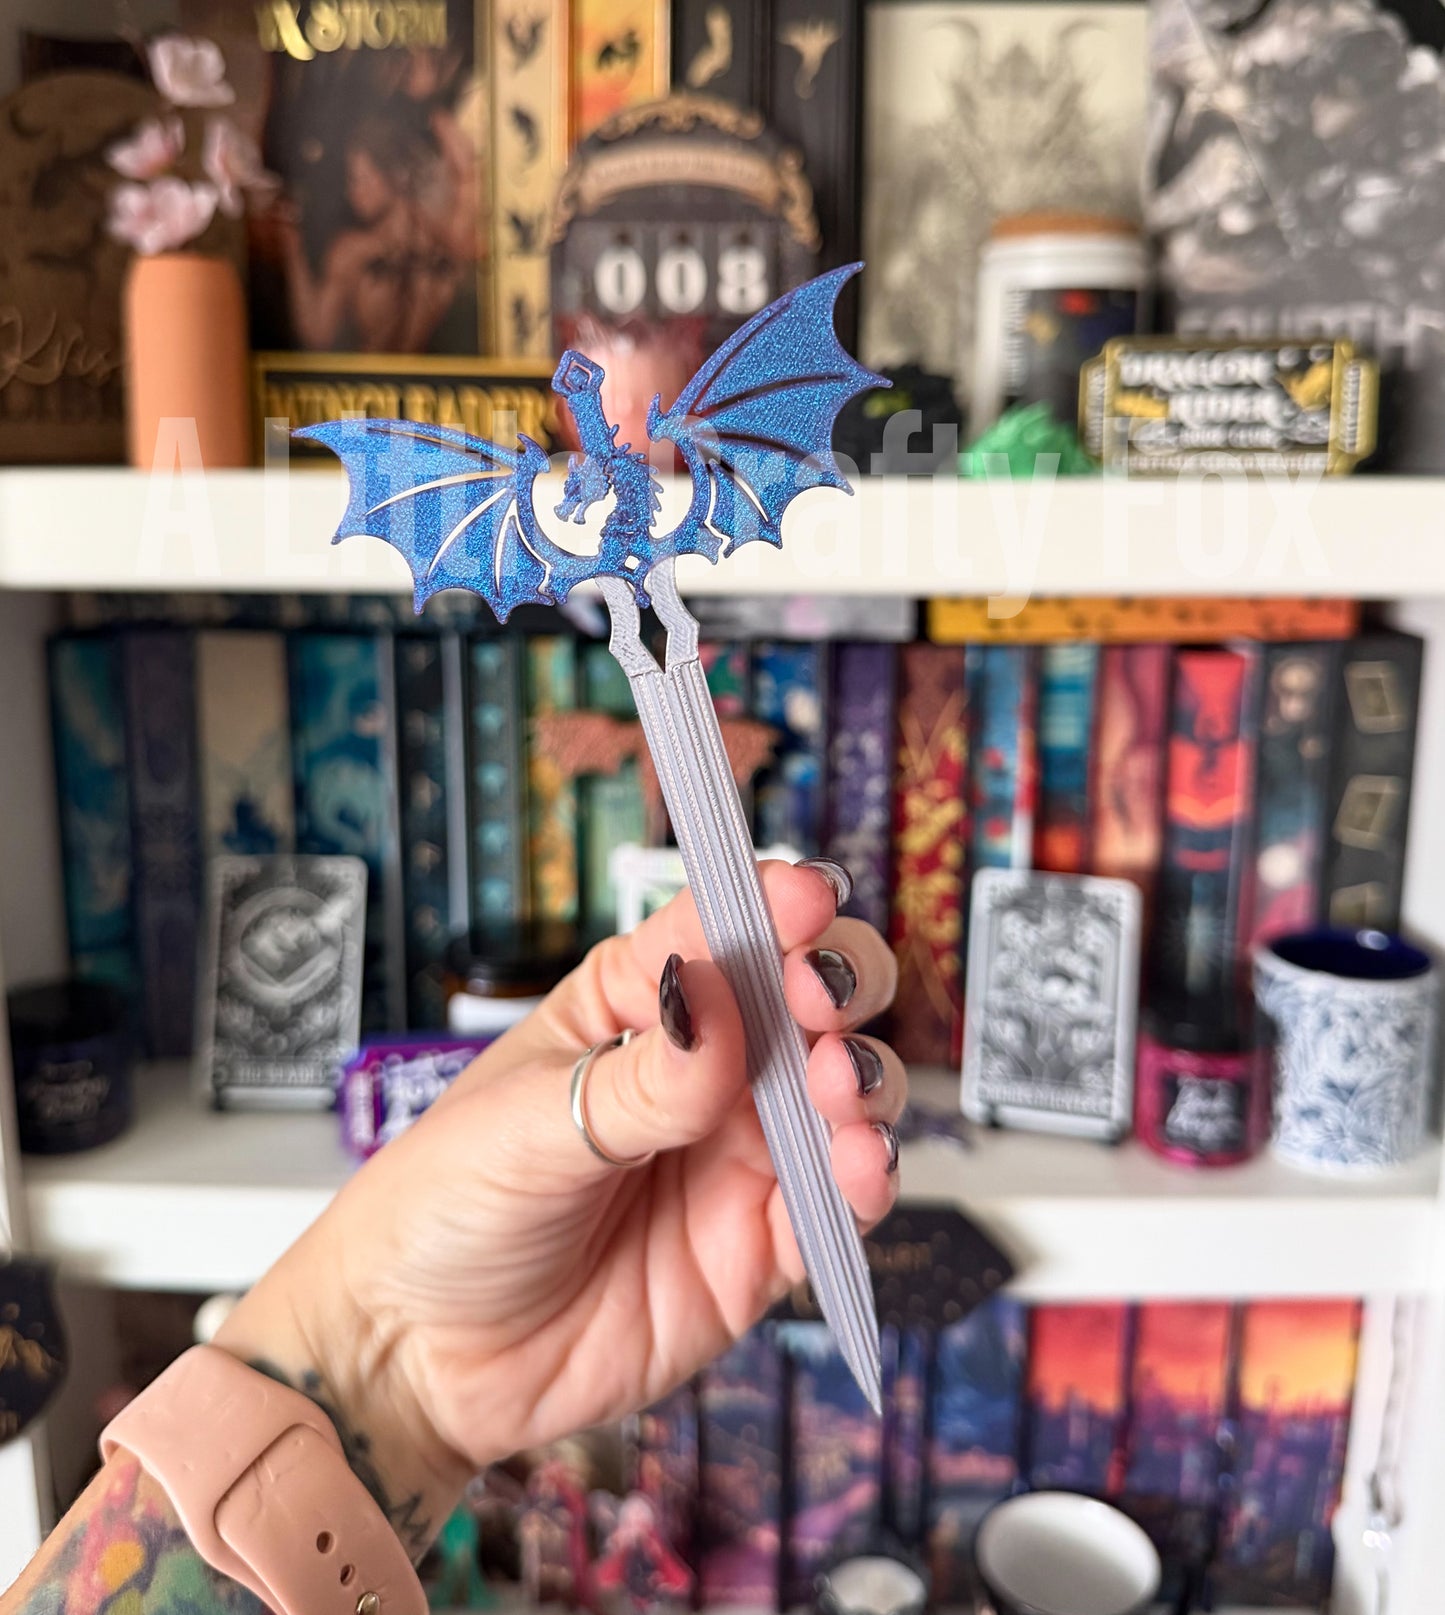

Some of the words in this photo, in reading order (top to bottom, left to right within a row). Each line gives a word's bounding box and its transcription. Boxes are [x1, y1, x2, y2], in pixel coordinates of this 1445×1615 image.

[306, 0, 447, 52] STORM
[594, 246, 769, 314] 008
[1119, 350, 1278, 392] DRAGON
[1168, 389, 1294, 429] RIDER
